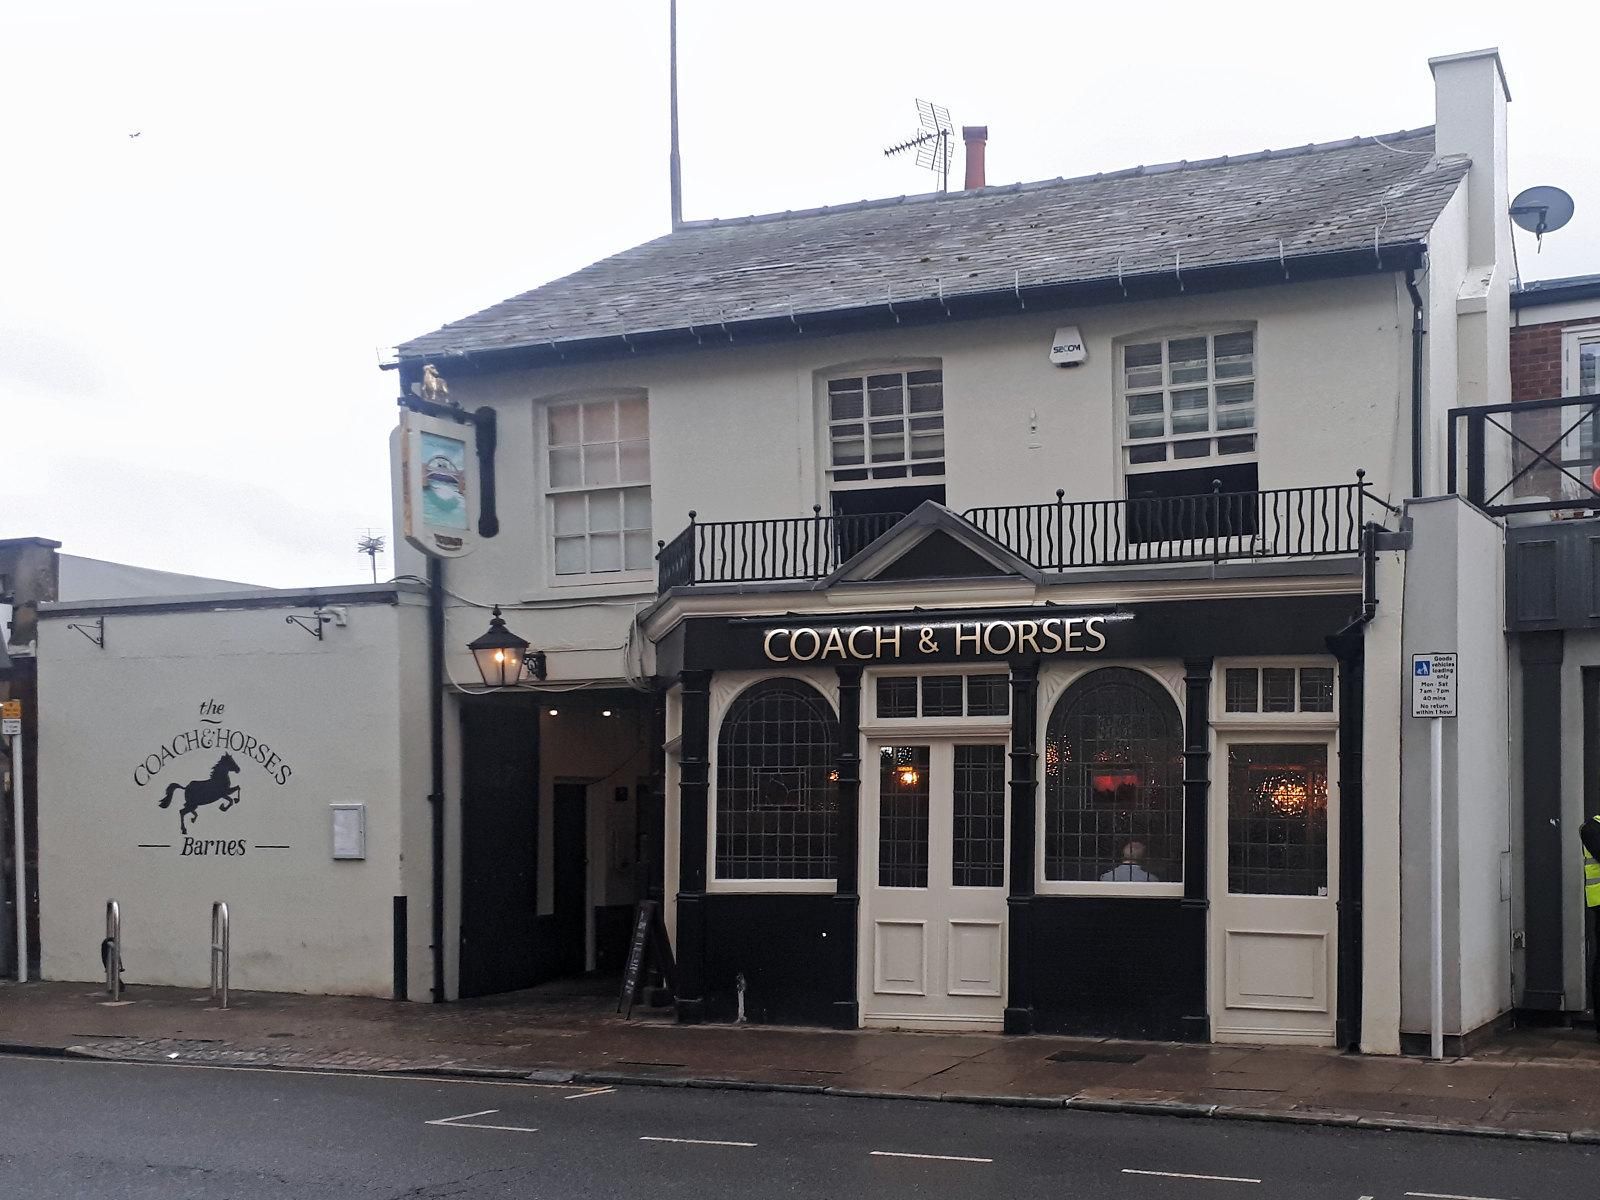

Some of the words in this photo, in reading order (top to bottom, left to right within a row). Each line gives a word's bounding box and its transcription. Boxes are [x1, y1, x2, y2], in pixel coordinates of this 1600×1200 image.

[1053, 344, 1081, 354] SECOM
[763, 625, 901, 662] COACH
[918, 627, 939, 654] &
[955, 616, 1106, 656] HORSES
[200, 698, 225, 715] the
[134, 729, 200, 787] COACH
[200, 728, 215, 749] &
[215, 728, 292, 786] HORSES
[180, 836, 247, 857] Barnes
